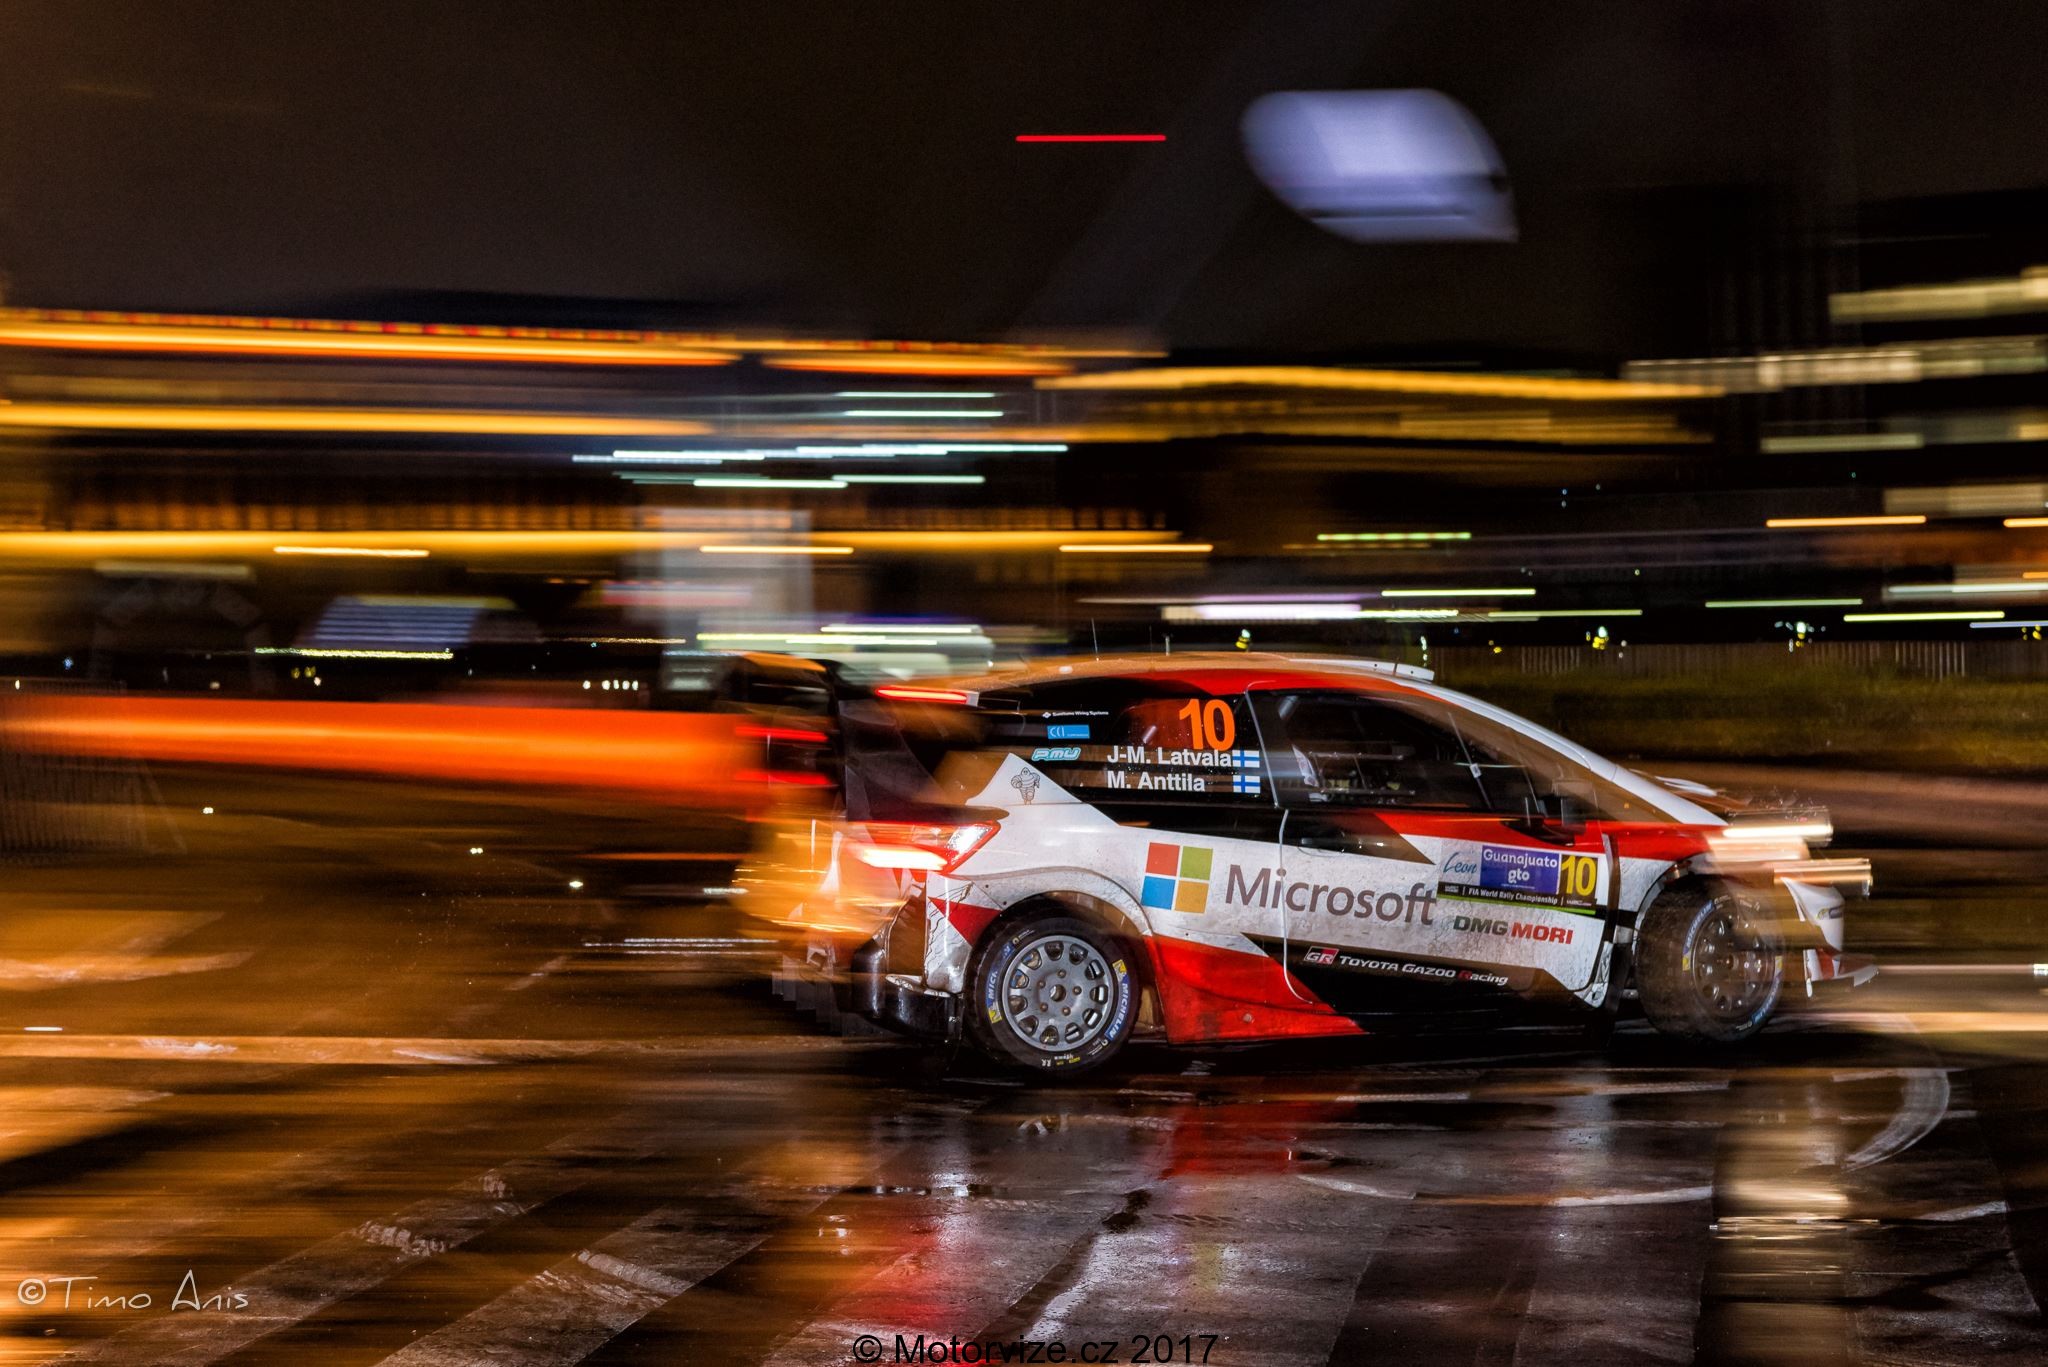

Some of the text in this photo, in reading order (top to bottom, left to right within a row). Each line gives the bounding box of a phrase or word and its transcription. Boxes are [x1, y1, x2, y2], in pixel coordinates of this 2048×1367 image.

[1179, 698, 1236, 751] 10
[1107, 745, 1232, 768] J-M. Latvala
[1107, 770, 1206, 792] M. Anttila
[1482, 848, 1558, 868] Guanajuato
[1508, 867, 1531, 884] gto
[1561, 855, 1596, 896] 10
[1225, 864, 1437, 927] Microsoft
[1468, 888, 1479, 896] FIA
[1480, 889, 1499, 898] World
[1499, 891, 1515, 900] Rally
[1515, 892, 1558, 905] Championship
[1453, 915, 1573, 945] DMG MORI
[1305, 951, 1335, 965] GR
[1339, 955, 1509, 986] TOYOTA GAZOO Racing
[1109, 981, 1130, 1040] MICHELIN
